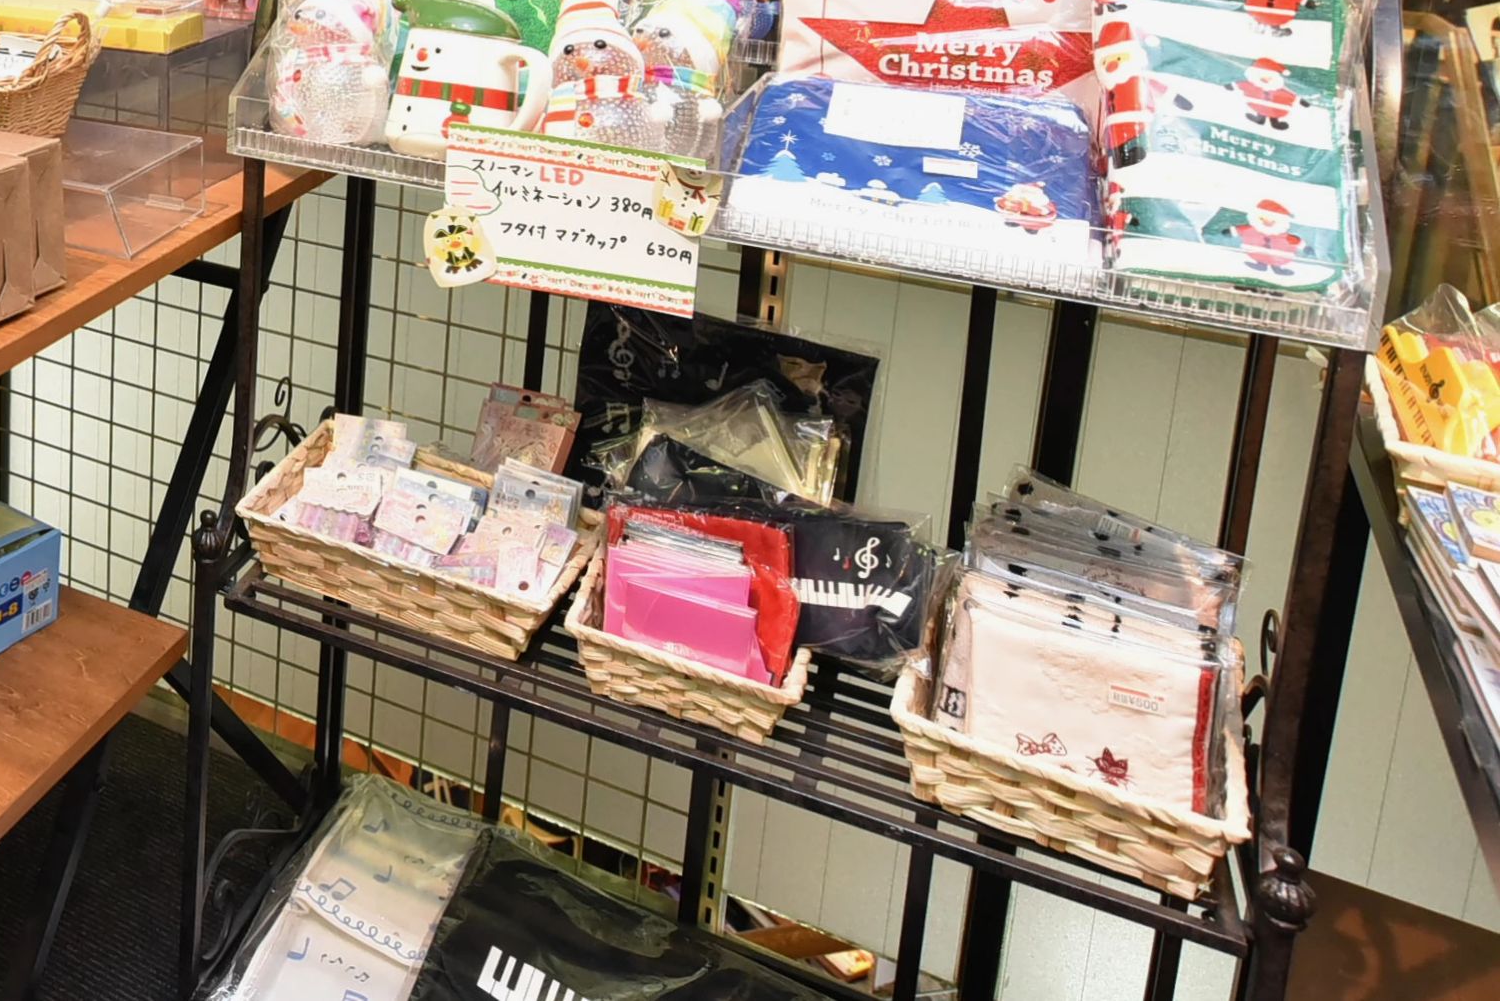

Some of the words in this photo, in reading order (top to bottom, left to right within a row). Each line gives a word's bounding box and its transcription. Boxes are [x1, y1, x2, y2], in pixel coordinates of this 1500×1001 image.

[915, 32, 1022, 66] Merry
[878, 53, 1054, 88] Christmas
[1209, 125, 1275, 156] Merry
[472, 158, 534, 178] スノーマン
[539, 165, 585, 186] LED
[491, 181, 601, 210] イルミネーション
[610, 197, 653, 220] 380円
[501, 222, 546, 240] フタ付
[555, 228, 628, 250] マグカップ
[646, 241, 693, 265] 630円
